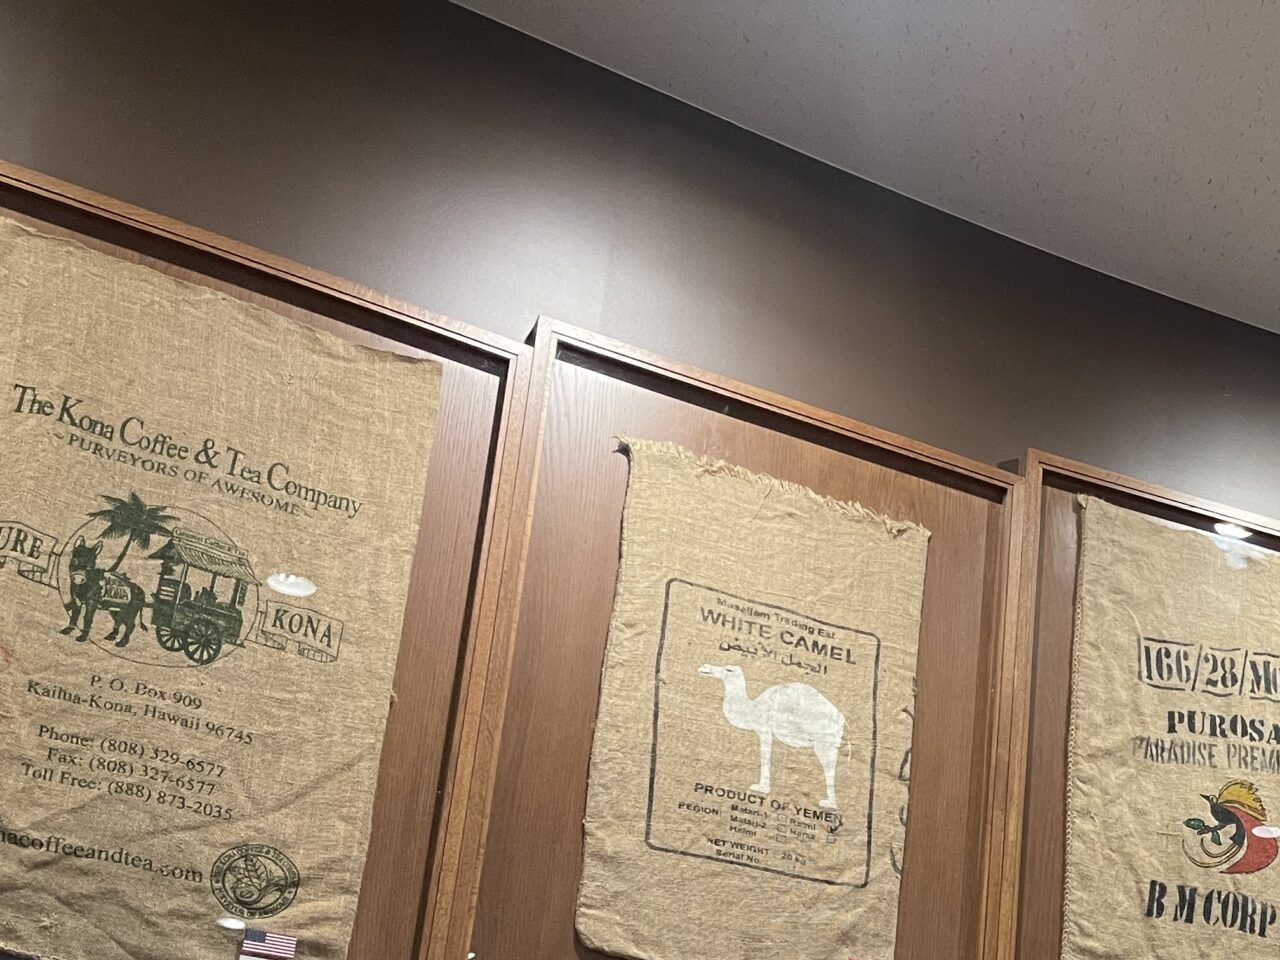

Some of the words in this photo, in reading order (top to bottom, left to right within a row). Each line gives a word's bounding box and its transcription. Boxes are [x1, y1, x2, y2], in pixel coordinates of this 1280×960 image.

[13, 383, 55, 416] The
[56, 394, 114, 441] Kona
[120, 416, 189, 460] Coffee
[194, 438, 221, 468] &
[226, 447, 261, 484] Tea
[267, 462, 363, 518] Company
[68, 433, 179, 478] PURVEYORS
[184, 469, 209, 483] OF
[212, 479, 300, 516] AWESOME
[272, 608, 332, 648] KONA
[700, 607, 773, 639] WHITE
[780, 630, 857, 665] CAMEL
[26, 679, 137, 716] Kailua-Kona,
[143, 704, 200, 731] Hawaii
[205, 721, 254, 745] 96745
[109, 678, 128, 692] O.
[134, 682, 166, 700] Box
[172, 692, 202, 710] 909
[38, 725, 94, 748] Phone:
[100, 737, 145, 759] (808)
[150, 745, 226, 779] 329-6577
[47, 748, 83, 766] Fax:
[89, 756, 134, 777] (808)
[139, 764, 217, 796] 327-6577
[1133, 735, 1217, 769] PARADISE
[21, 762, 54, 783] Toll
[60, 771, 101, 791] Free:
[108, 780, 151, 802] (888)
[156, 790, 233, 821] 873-2035
[693, 782, 766, 807] PRODUCT
[770, 799, 789, 811] OF
[794, 805, 843, 826] YEMEN
[706, 837, 726, 848] NET
[730, 841, 769, 856] WEIGHT
[716, 849, 743, 861] Serial
